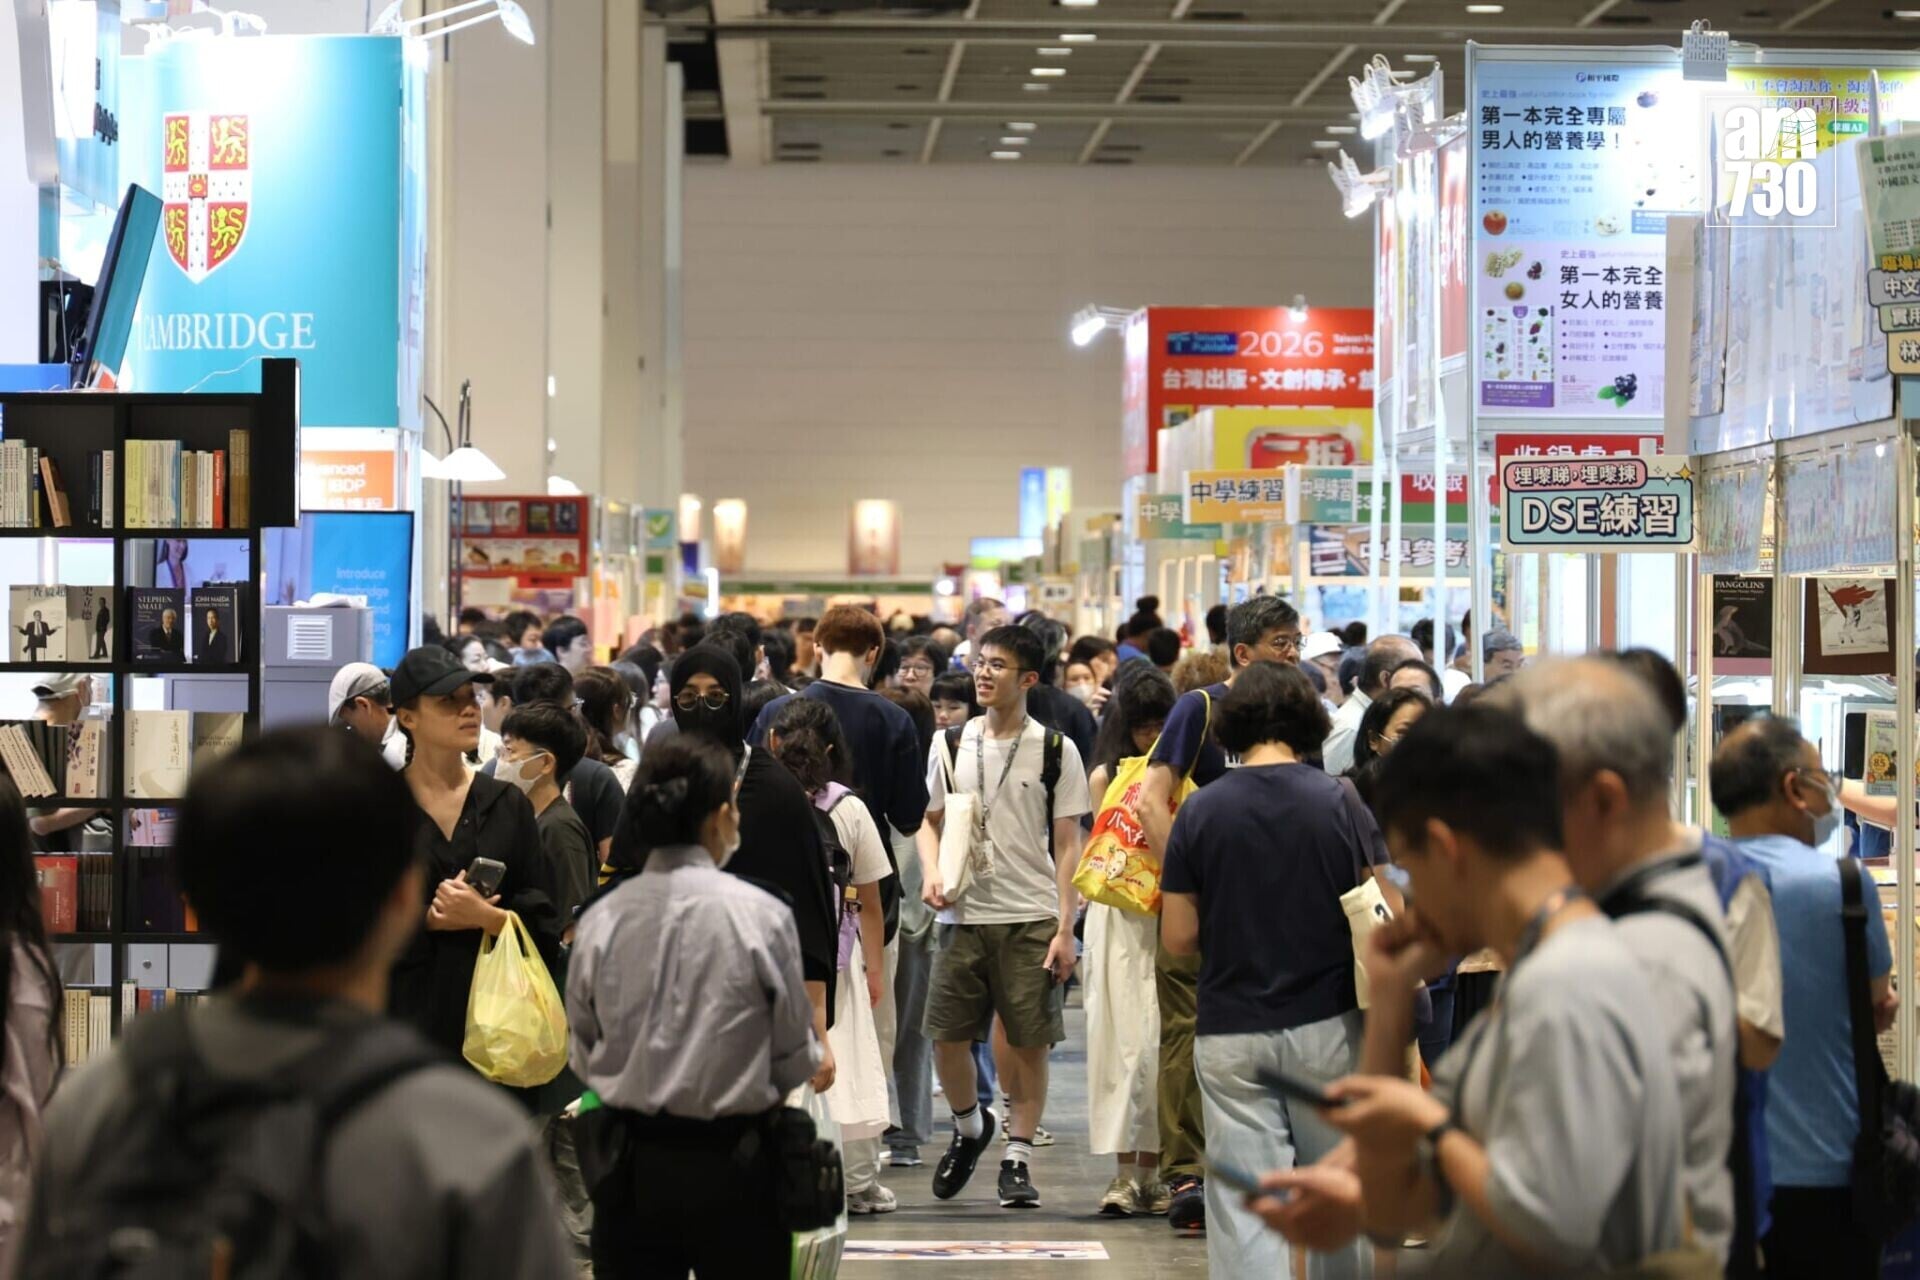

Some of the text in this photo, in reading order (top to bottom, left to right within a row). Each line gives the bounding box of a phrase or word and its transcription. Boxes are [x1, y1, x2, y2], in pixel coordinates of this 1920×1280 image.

[1481, 106, 1626, 126] 第一本完全專屬
[1481, 130, 1620, 150] 男人的營養學！
[1560, 265, 1663, 285] 第一本完全
[1560, 290, 1663, 310] 女人的營養
[144, 312, 316, 350] CAMBRIDGE
[1240, 331, 1324, 357] 2026
[1190, 479, 1285, 503] 中學練習
[1300, 479, 1353, 501] 中學練習
[1522, 491, 1680, 538] DSE練習
[336, 567, 387, 580] Introduce
[1715, 580, 1765, 589] PANGOLINS
[138, 595, 173, 603] STEPHEN
[195, 595, 210, 603] JOHN
